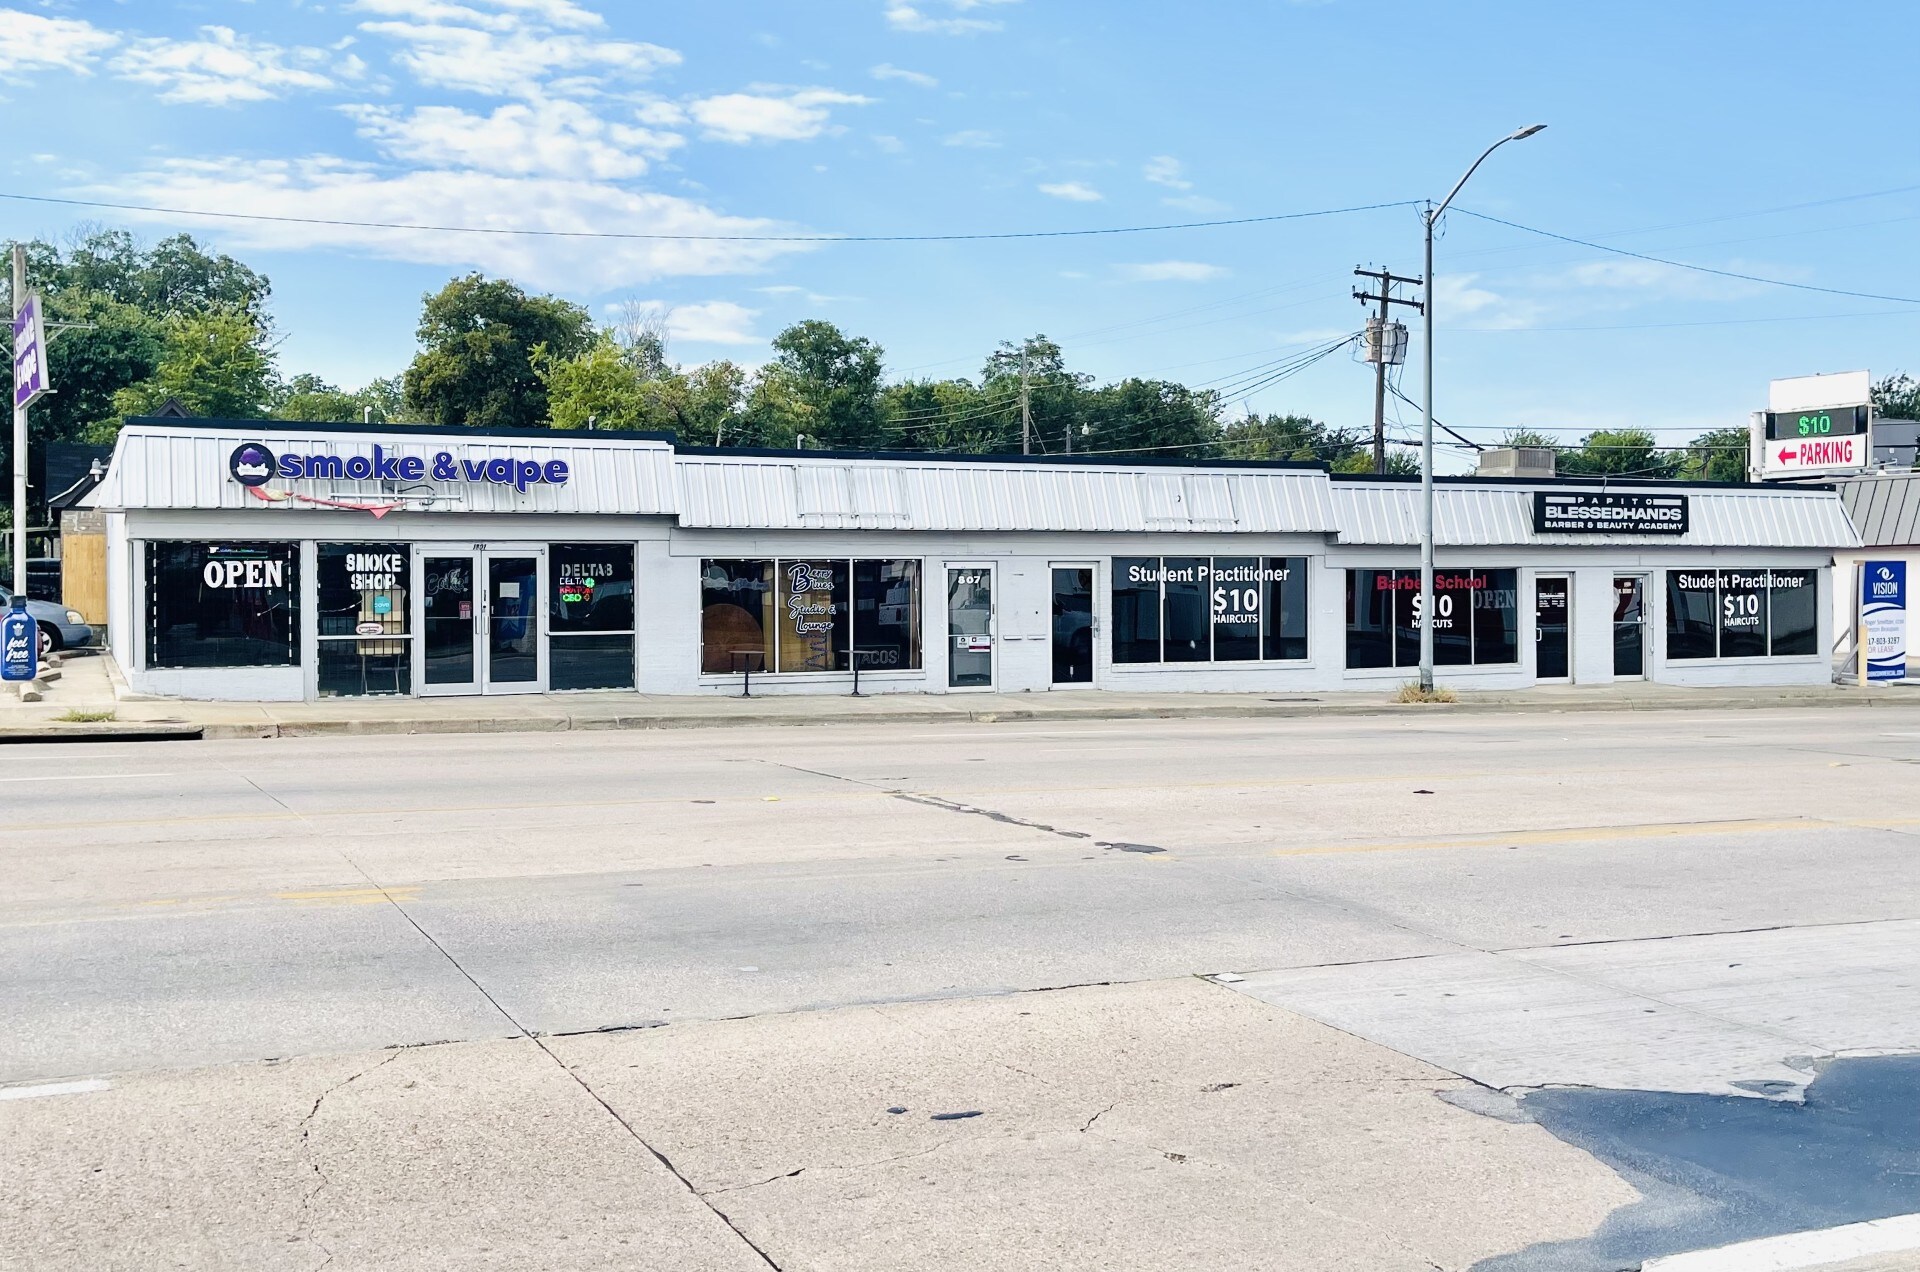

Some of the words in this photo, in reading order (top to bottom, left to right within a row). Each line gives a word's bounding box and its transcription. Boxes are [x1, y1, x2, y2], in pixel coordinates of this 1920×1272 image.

[1798, 416, 1831, 436] $10
[1800, 440, 1853, 465] PARKING
[277, 443, 425, 482] smoke
[431, 452, 460, 482] &
[462, 457, 570, 494] vape
[1545, 505, 1682, 520] BLESSEDHANDS
[1587, 521, 1593, 529] &
[1638, 522, 1684, 530] ACADEMY
[346, 554, 402, 572] SMOKE
[203, 560, 283, 589] OPEN
[351, 573, 396, 590] SHOP
[957, 575, 981, 584] 807
[1128, 565, 1194, 582] Student
[1198, 565, 1290, 582] Practitioner
[1678, 574, 1729, 589] Student
[1732, 574, 1804, 588] Practitioner
[1377, 575, 1422, 590] Barbe
[1435, 575, 1487, 590] School
[1873, 582, 1898, 595] VISION
[788, 594, 826, 619] Studio
[1213, 586, 1258, 613] $10
[1474, 589, 1516, 609] OPEN
[1723, 593, 1759, 618] $10
[796, 615, 834, 634] Lounge
[1213, 614, 1258, 624] HAIRCUTS
[1411, 619, 1453, 629] HACUTS
[1724, 616, 1759, 627] HAIRCUTS
[7, 637, 28, 651] feel
[1877, 645, 1895, 653] LEASE
[6, 648, 29, 662] free
